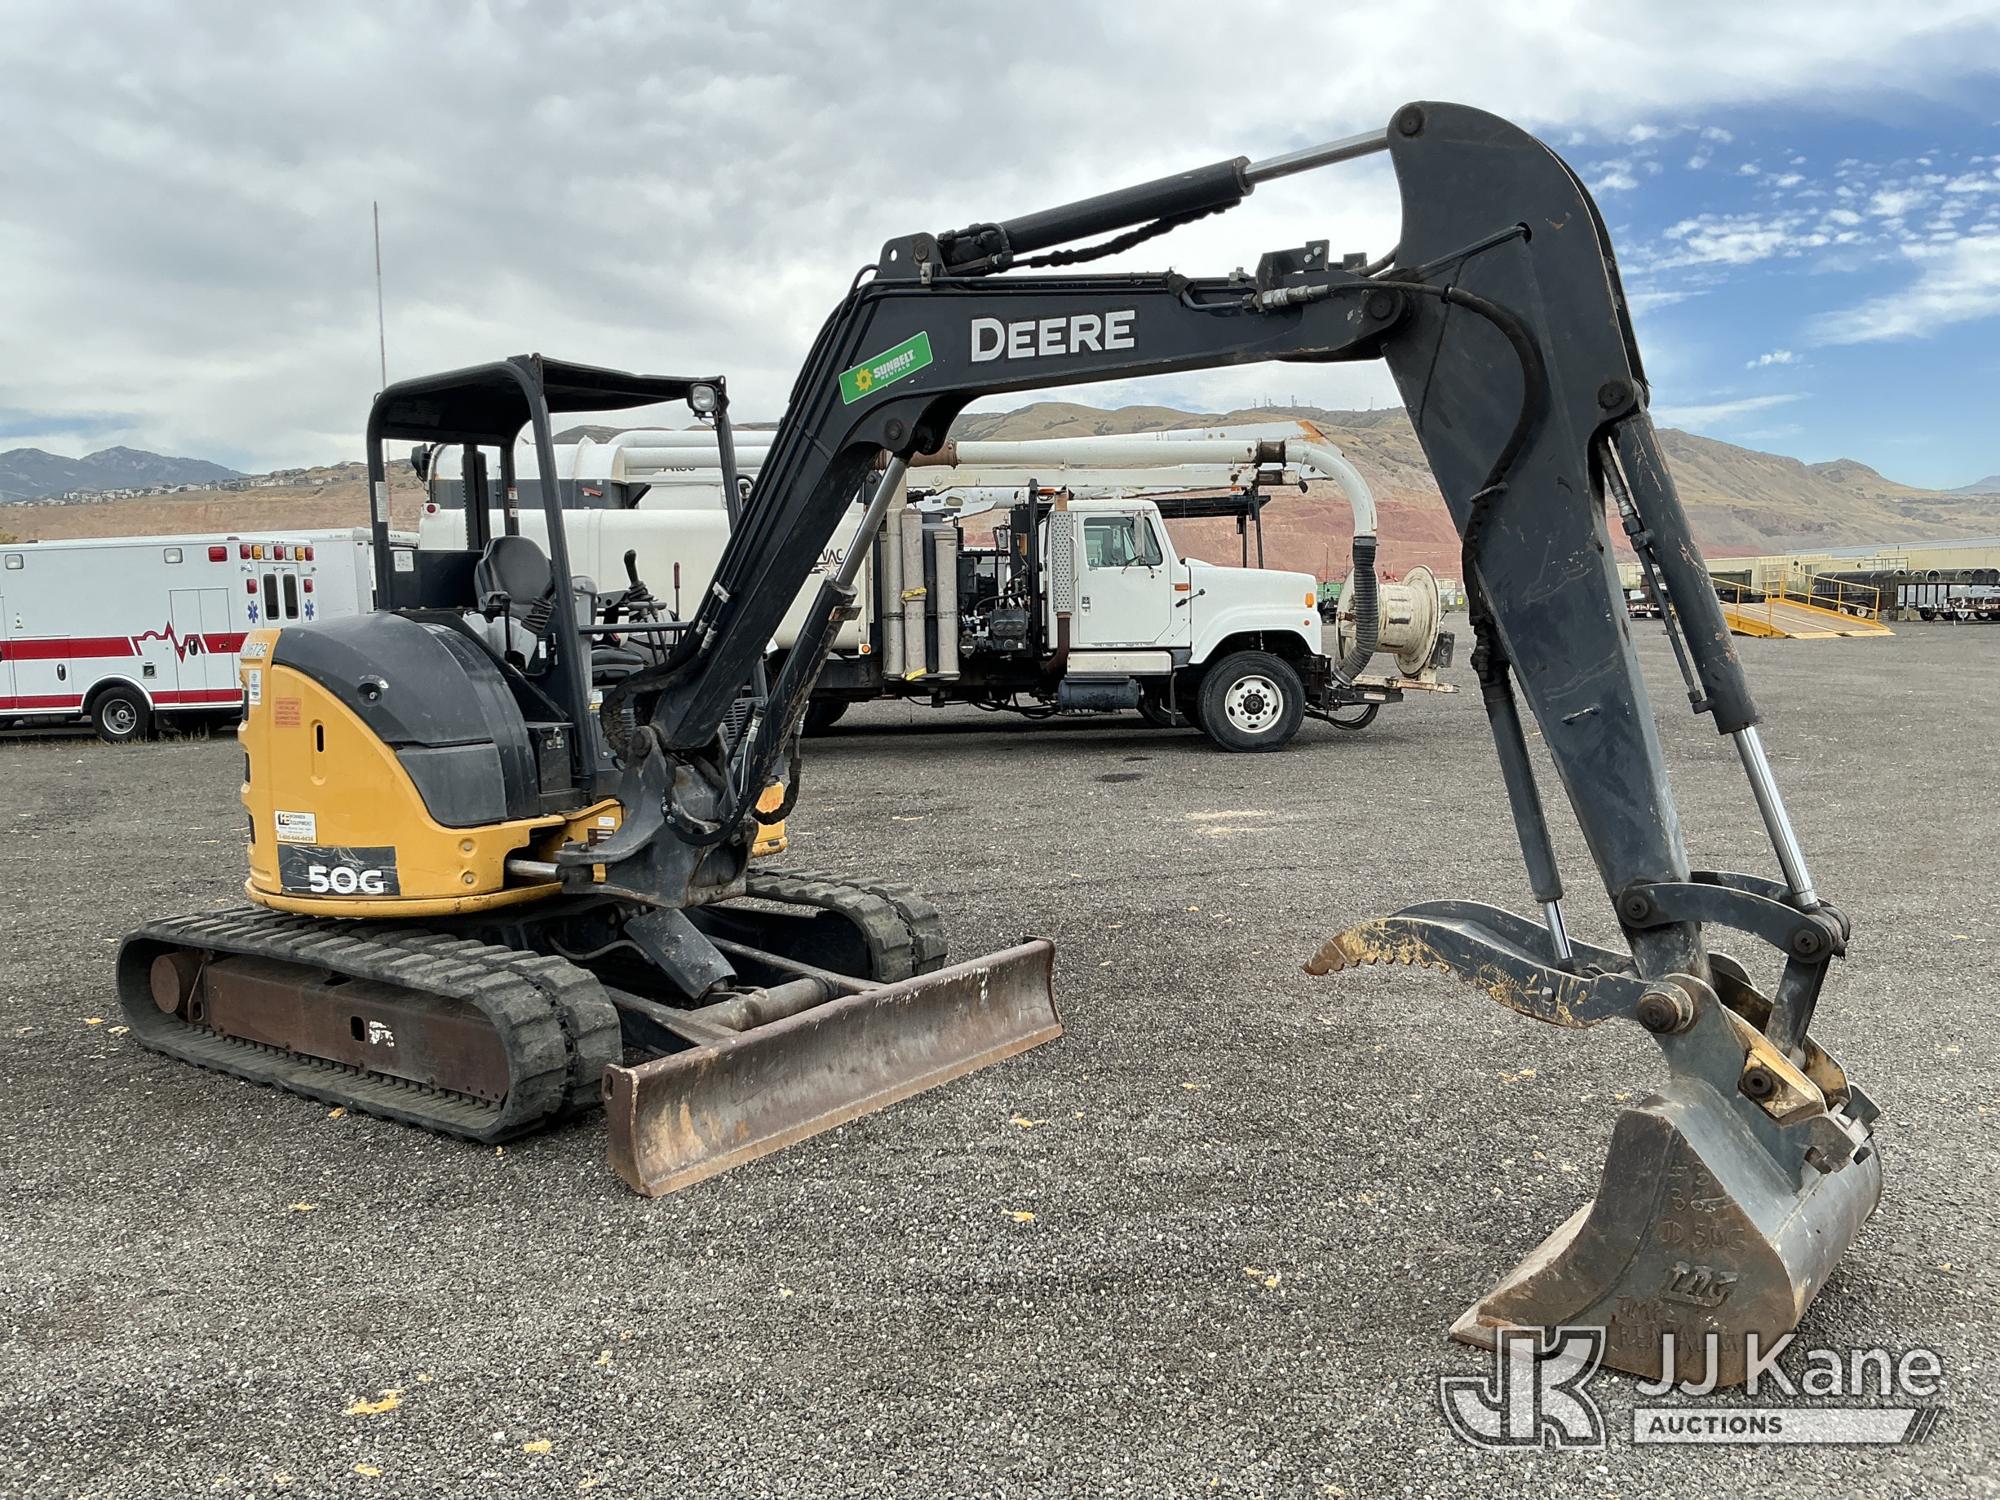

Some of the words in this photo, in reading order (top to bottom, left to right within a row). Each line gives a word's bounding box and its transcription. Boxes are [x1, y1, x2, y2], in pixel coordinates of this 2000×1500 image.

[971, 310, 1135, 362] DEERE
[873, 349, 914, 379] SUNBELT
[308, 865, 384, 894] 50G
